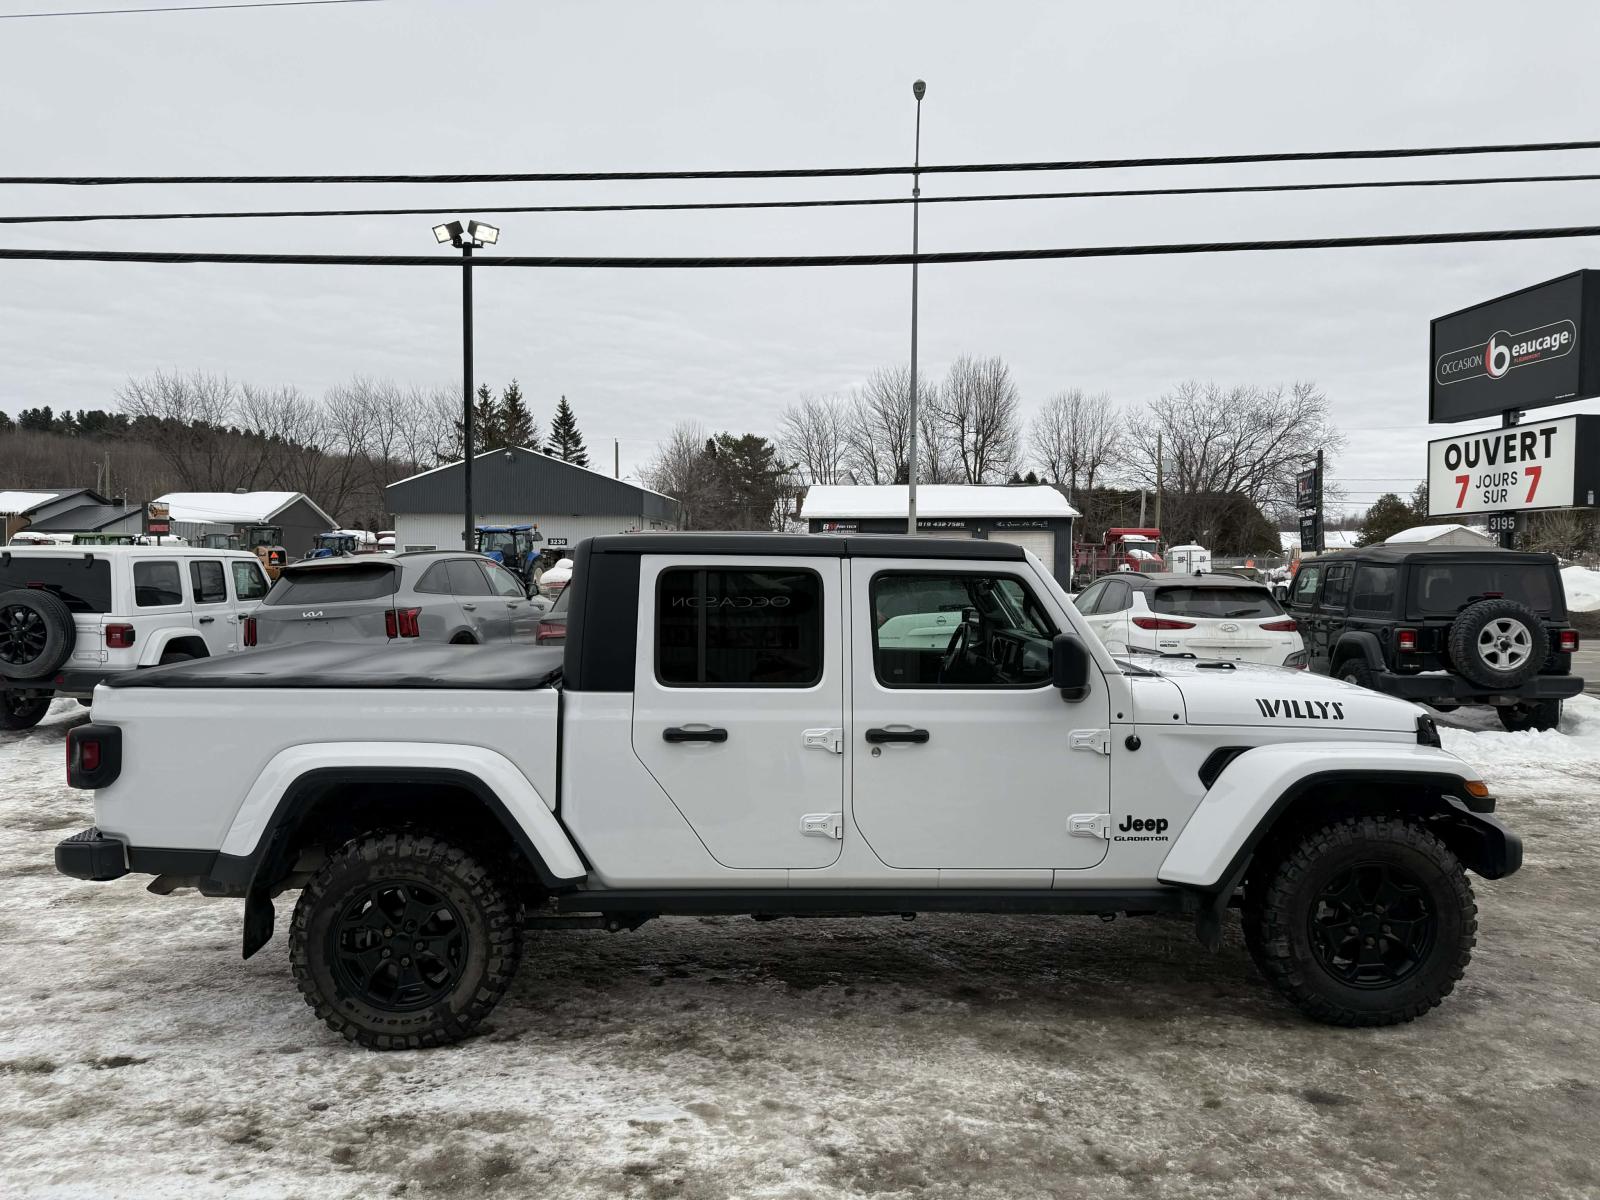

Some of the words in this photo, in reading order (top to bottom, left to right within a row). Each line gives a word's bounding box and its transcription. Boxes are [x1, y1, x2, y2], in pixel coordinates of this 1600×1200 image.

[1441, 354, 1483, 375] OCCASION
[1444, 426, 1557, 471] OUVERT
[1455, 474, 1470, 508] 7
[1475, 471, 1518, 489] JOURS
[1524, 465, 1542, 503] 7
[1483, 488, 1508, 504] SUR
[1490, 517, 1515, 530] 3195
[1255, 698, 1344, 720] WILLYS
[1118, 815, 1168, 834] Jeep
